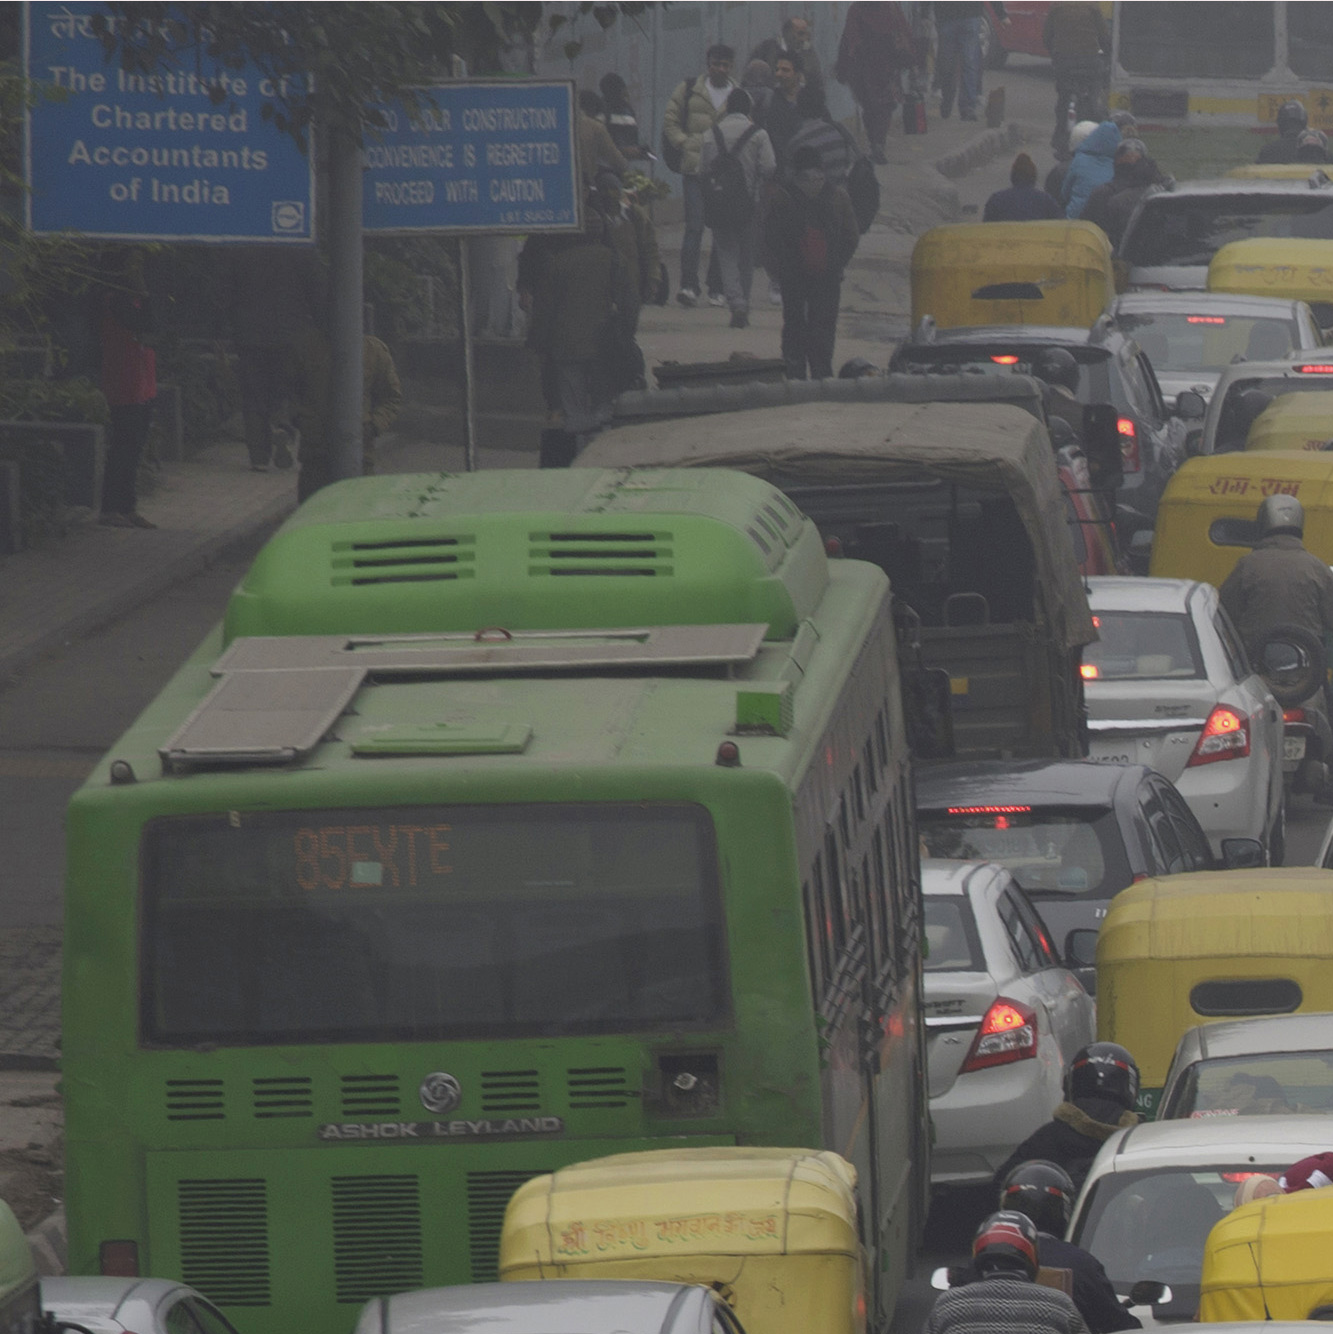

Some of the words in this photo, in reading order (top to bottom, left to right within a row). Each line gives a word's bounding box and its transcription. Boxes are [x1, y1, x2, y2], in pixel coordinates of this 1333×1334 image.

[48, 66, 106, 92] The
[117, 68, 248, 96] Institute
[258, 74, 289, 98] of
[91, 104, 248, 132] Chartered
[462, 107, 557, 131] CONSTRUCTION
[68, 140, 268, 170] Accountants
[463, 143, 476, 168] IS
[487, 142, 561, 166] REGRETTED
[109, 177, 142, 201] of
[152, 178, 230, 204] India
[375, 180, 435, 205] PROCEED
[446, 179, 479, 202] WITH
[489, 178, 546, 202] CAUTION
[322, 1122, 418, 1139] ASHOK
[432, 1115, 561, 1136] LEYLAND
